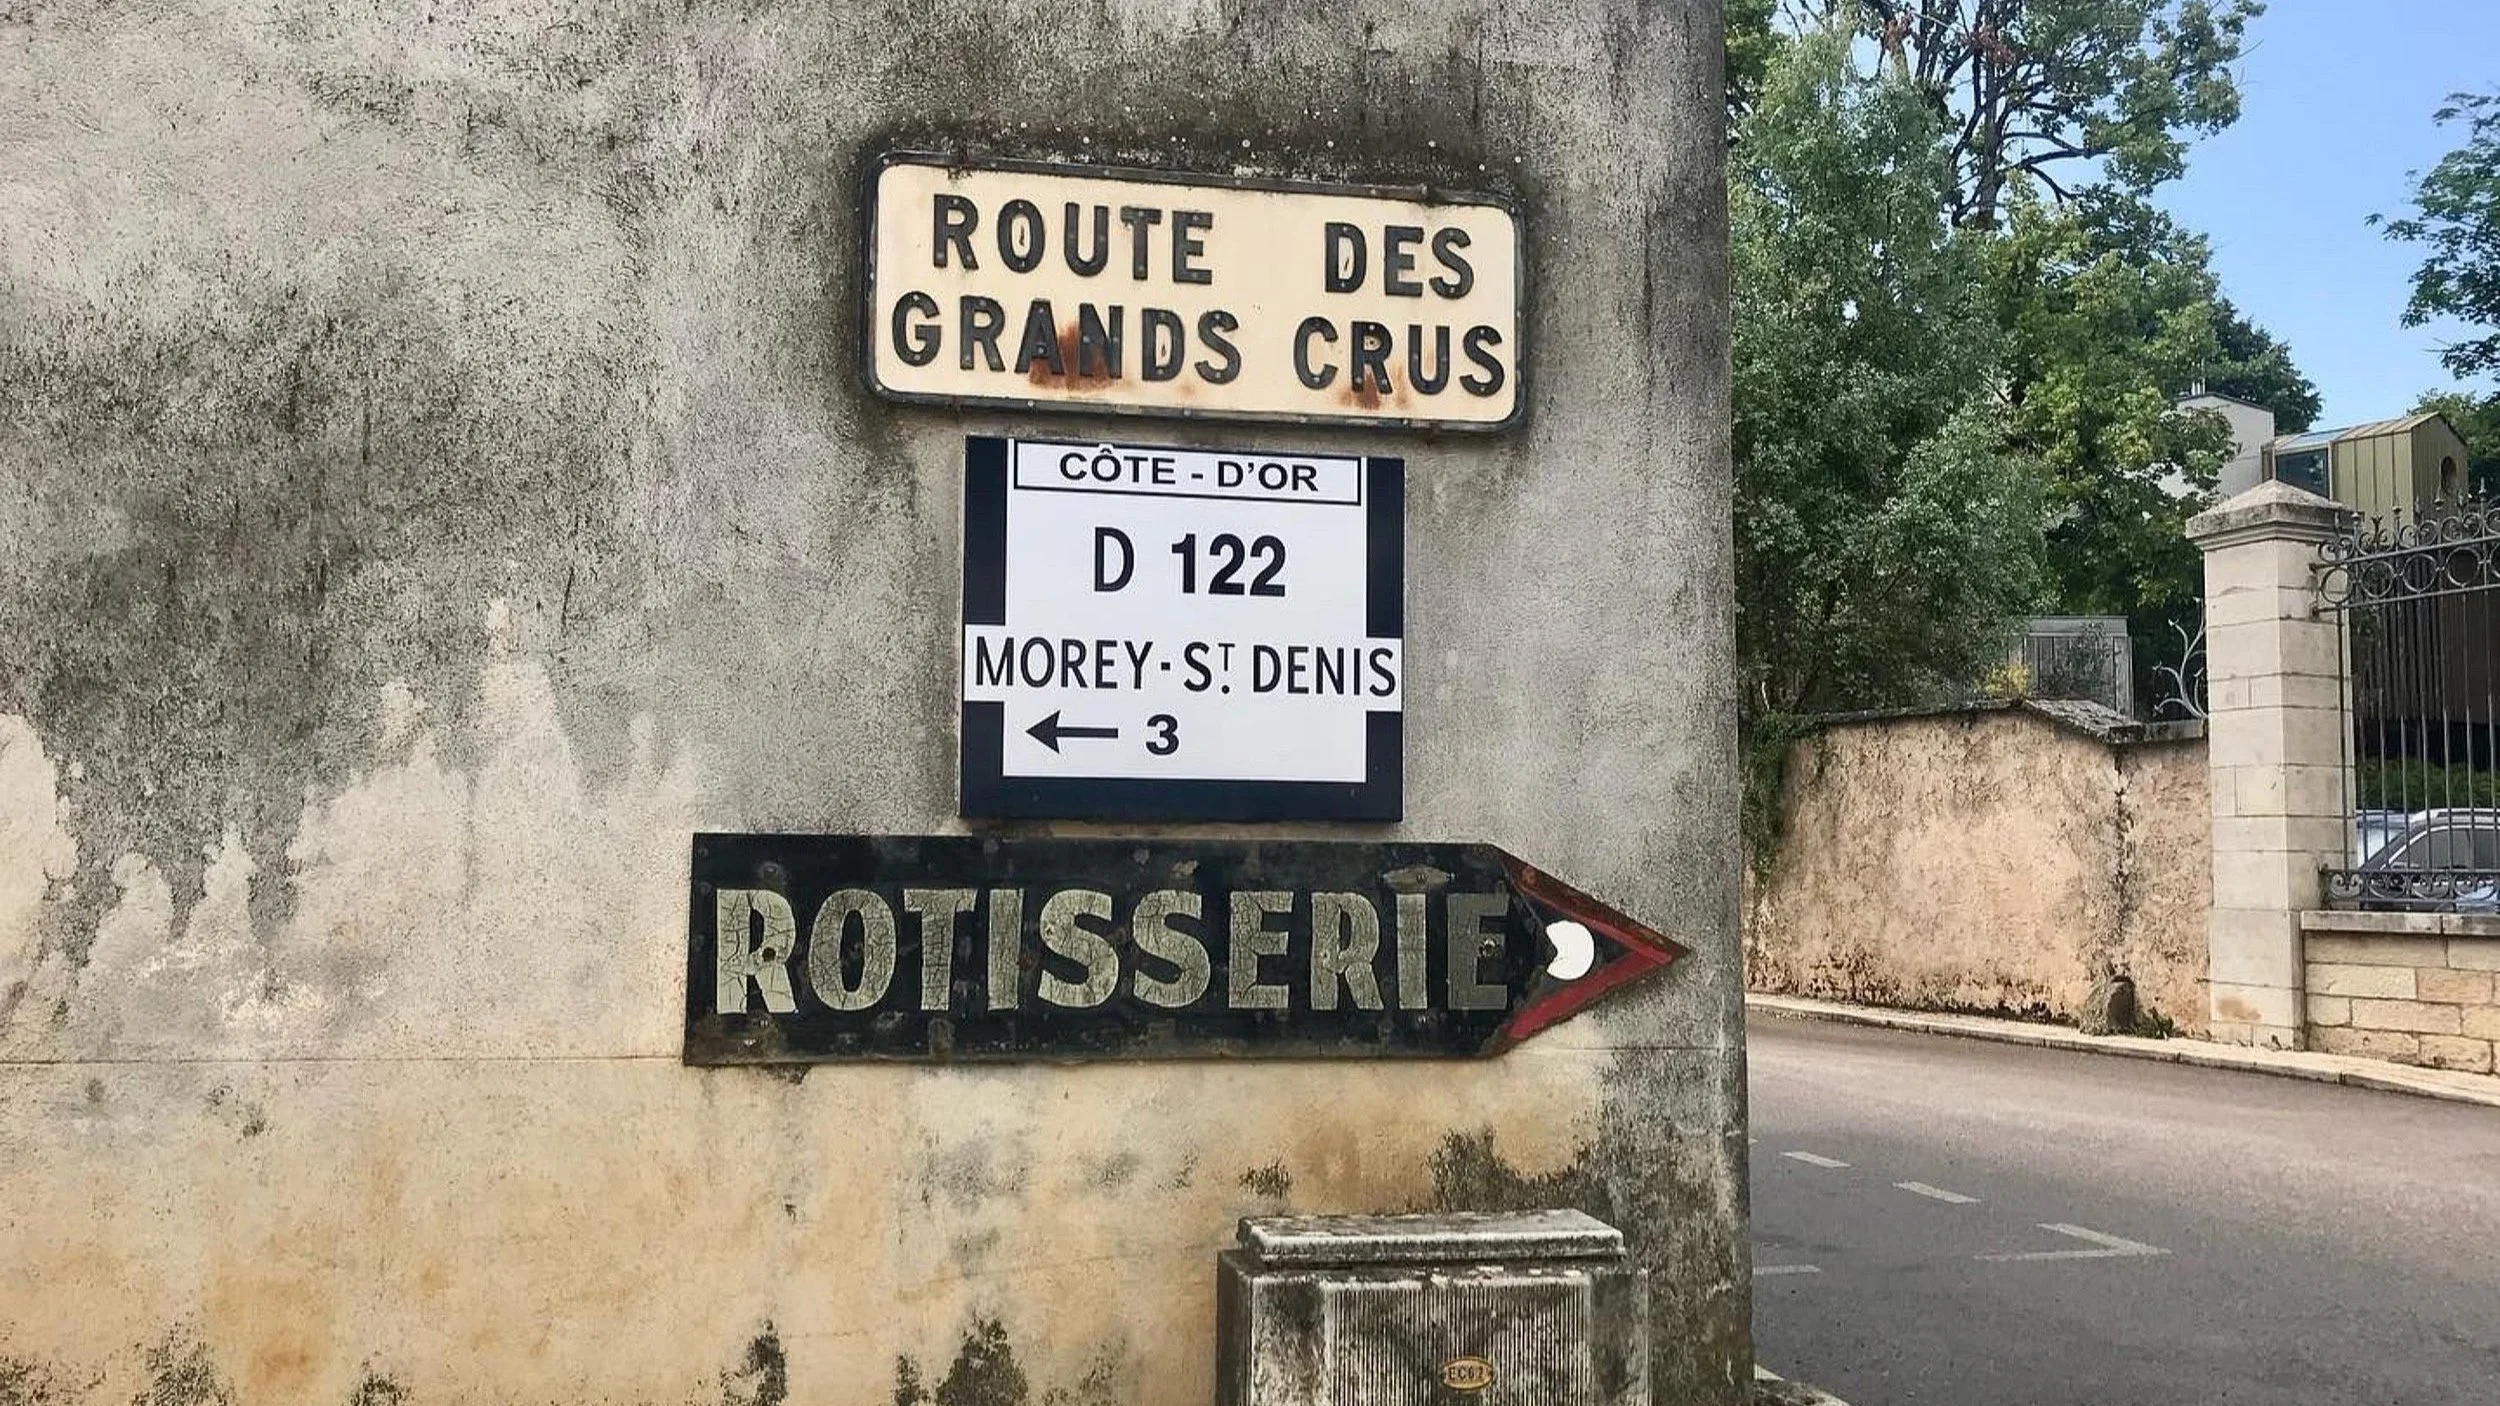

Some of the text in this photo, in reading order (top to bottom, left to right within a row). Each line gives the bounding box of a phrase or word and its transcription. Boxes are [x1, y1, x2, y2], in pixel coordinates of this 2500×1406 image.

[932, 194, 1475, 300] ROUTE DES
[891, 291, 1505, 397] GRANDS CRUS
[1059, 448, 1176, 485] CÔTE
[1217, 461, 1319, 492] D'OR
[1094, 526, 1286, 598] D 122
[1252, 644, 1397, 698] DENIS
[1145, 714, 1180, 756] 3
[715, 886, 1511, 1015] ROTISSERIE
